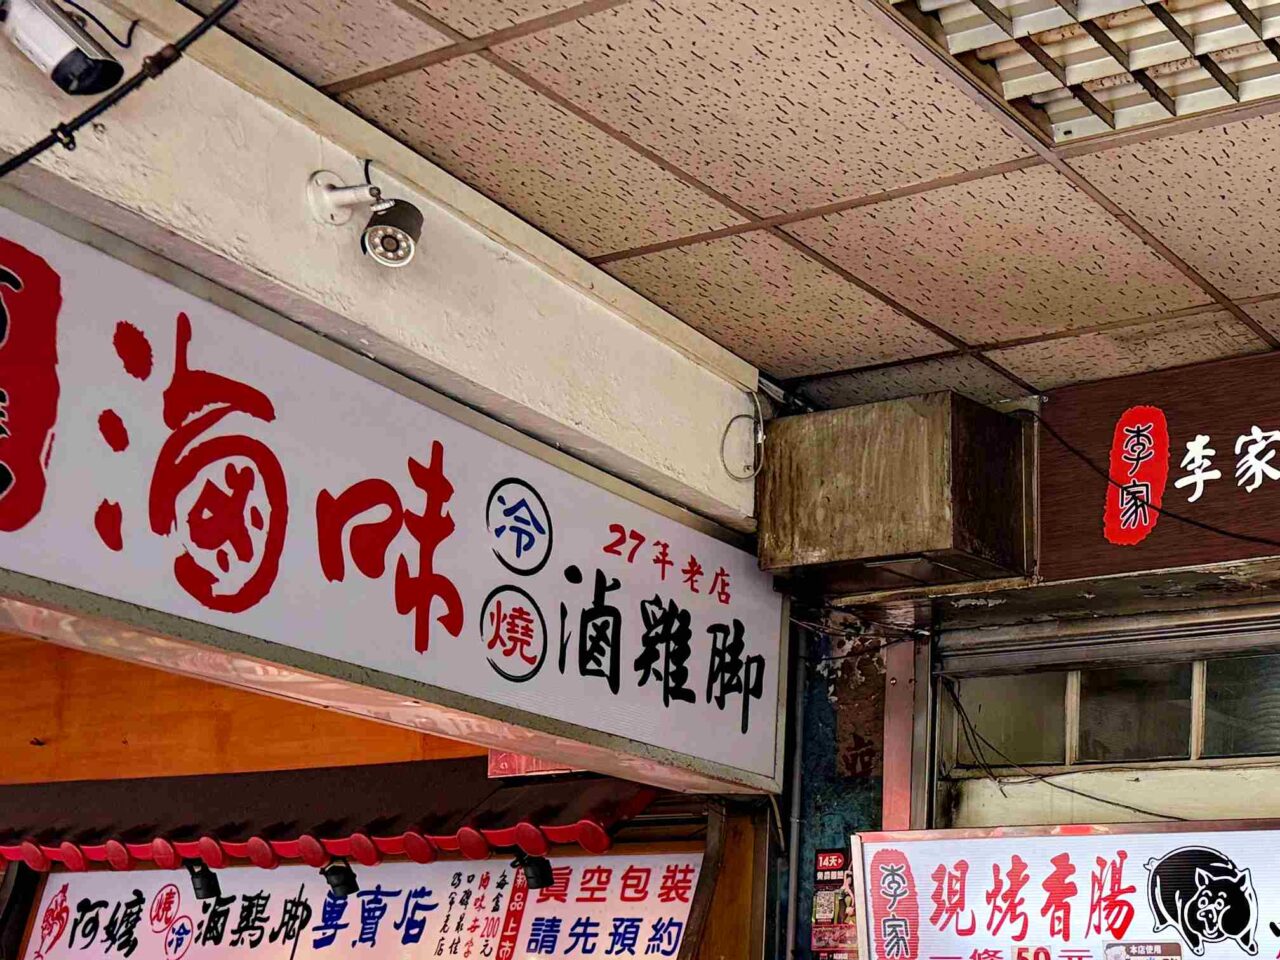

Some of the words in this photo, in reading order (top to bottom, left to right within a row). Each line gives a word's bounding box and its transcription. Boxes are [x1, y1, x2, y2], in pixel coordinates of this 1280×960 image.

[94, 311, 463, 654] 滷味
[1119, 422, 1155, 530] 李家
[494, 494, 546, 558] 冷
[602, 523, 731, 605] 27年老店
[487, 600, 538, 665] 燒
[526, 916, 684, 956] 請先預約
[879, 863, 911, 960] 李家
[929, 850, 1137, 942] 現烤香腸
[1129, 944, 1162, 955] 本店使用
